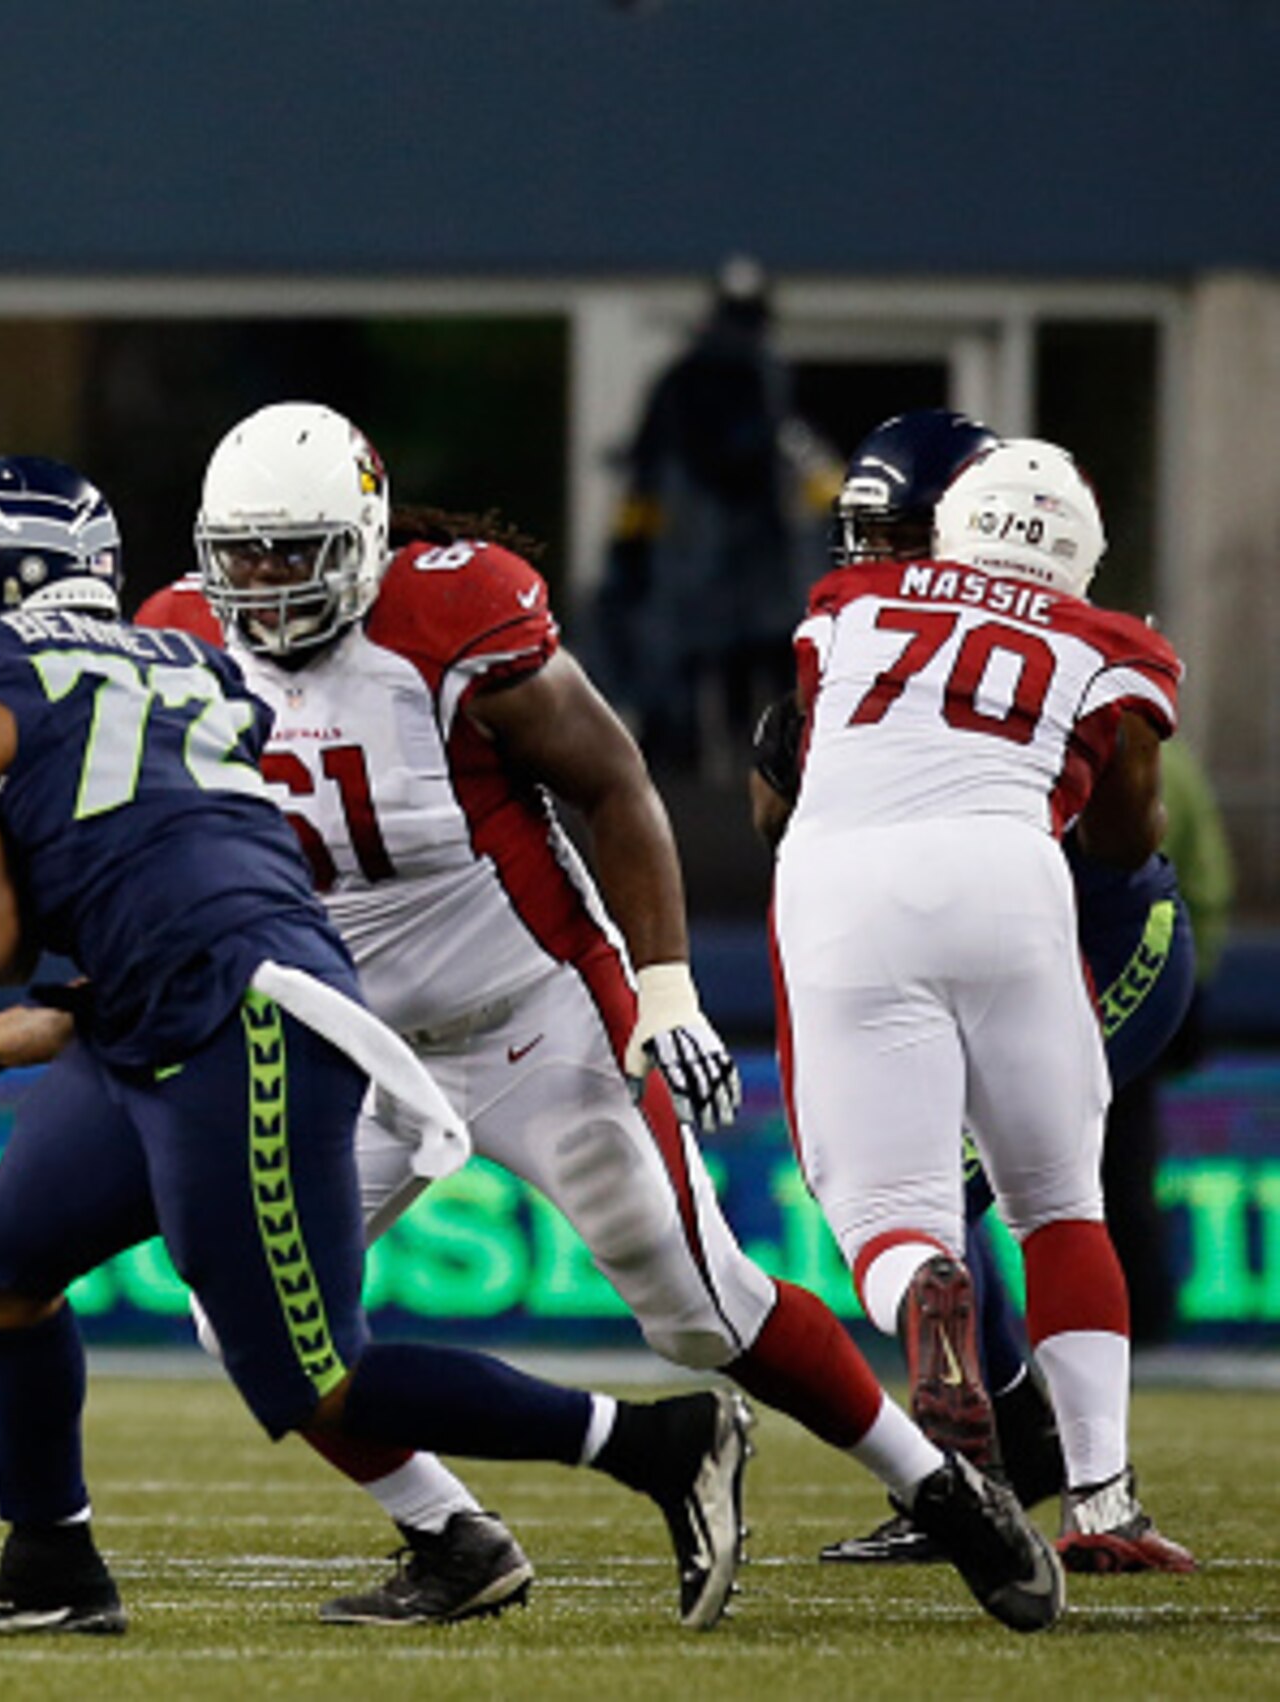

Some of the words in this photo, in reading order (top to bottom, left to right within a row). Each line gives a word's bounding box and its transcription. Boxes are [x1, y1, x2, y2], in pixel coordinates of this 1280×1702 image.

[0, 609, 208, 665] BENNETT
[900, 565, 1053, 625] MASSIE
[846, 607, 1058, 747] 70
[30, 648, 272, 821] 72
